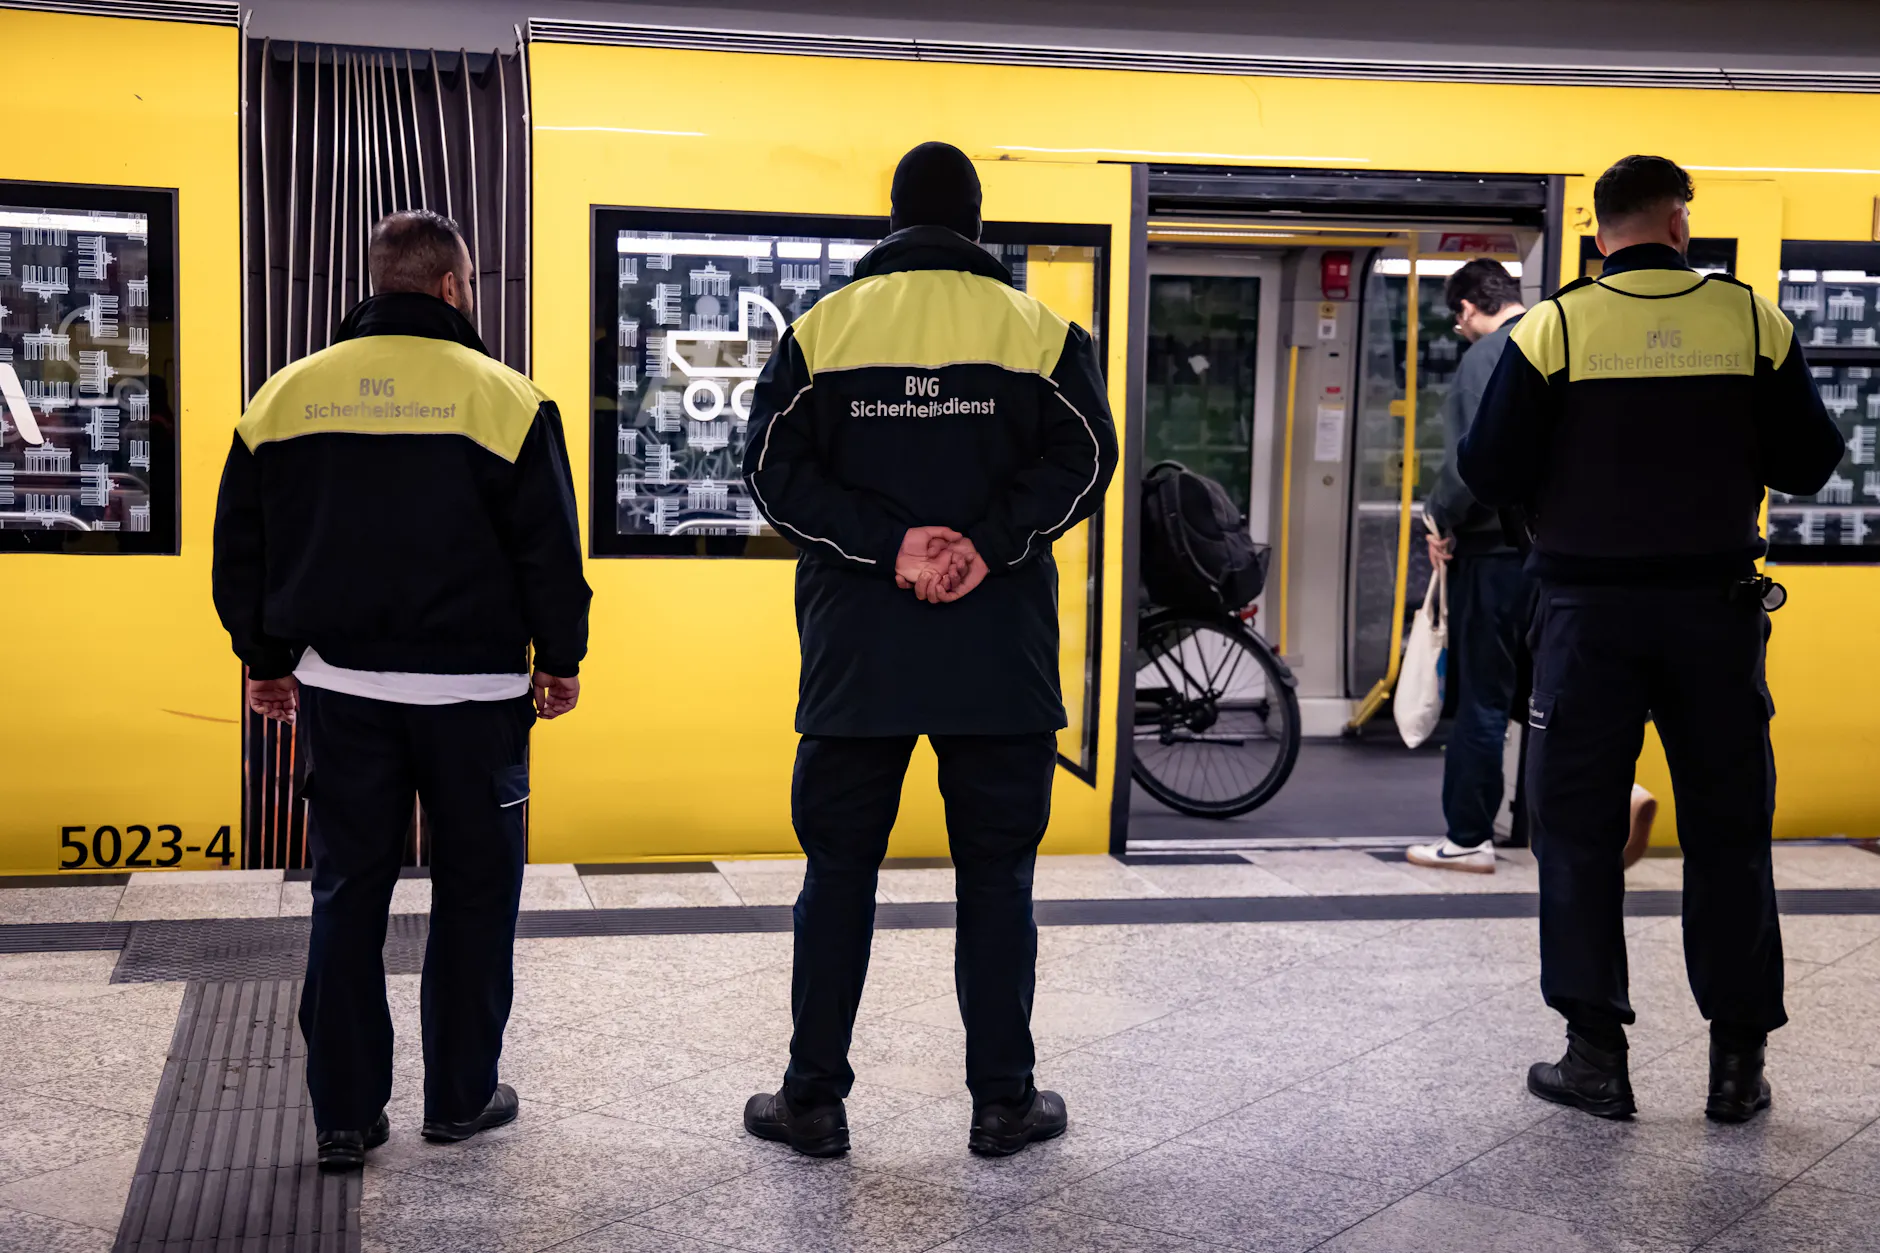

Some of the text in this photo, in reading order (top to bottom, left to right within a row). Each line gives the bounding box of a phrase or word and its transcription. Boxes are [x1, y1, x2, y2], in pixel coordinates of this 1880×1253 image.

[1588, 350, 1740, 371] Sicherheitsdienst
[359, 377, 395, 397] BVG
[905, 375, 940, 397] BVG
[304, 401, 456, 420] Sicherheitsdienst
[850, 397, 996, 418] Sicherheitsdienst
[61, 824, 235, 868] 5023-4
